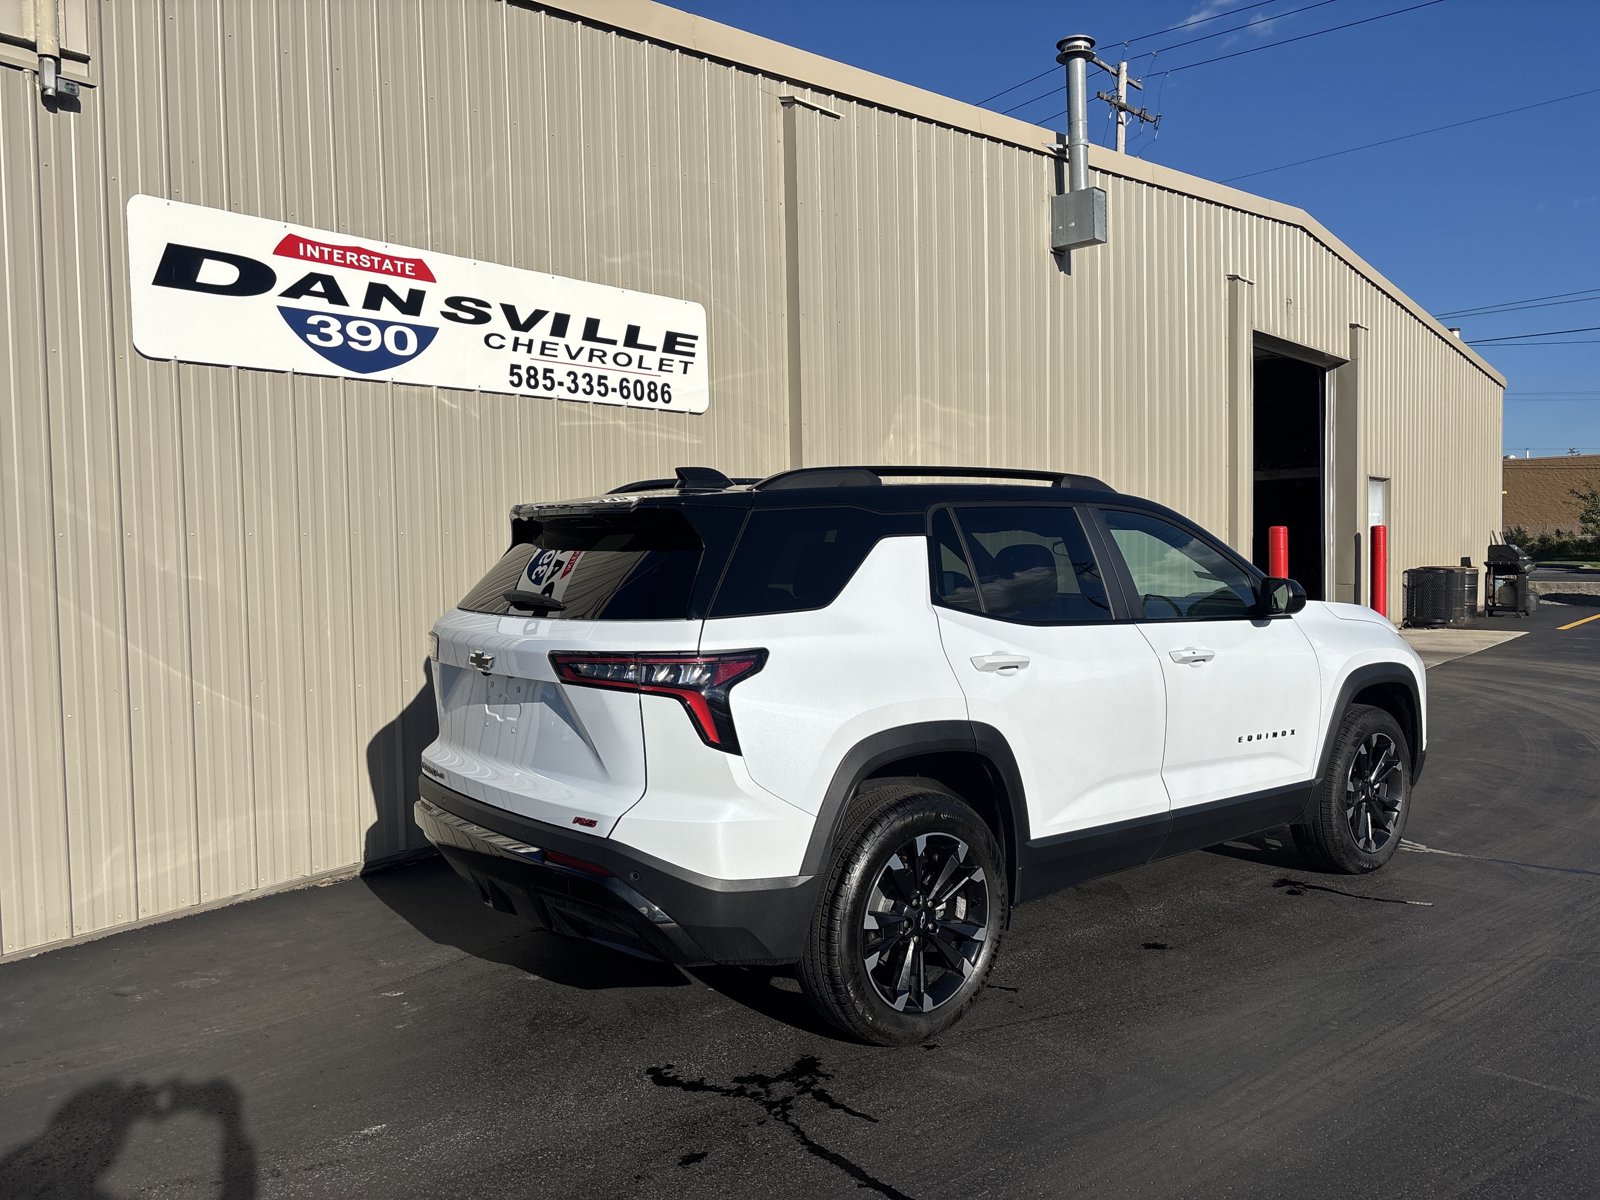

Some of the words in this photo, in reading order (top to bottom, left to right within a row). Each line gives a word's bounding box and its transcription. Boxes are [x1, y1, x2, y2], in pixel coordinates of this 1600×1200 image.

[298, 242, 416, 277] INTERSTATE
[151, 242, 699, 358] DANSVILLE
[306, 314, 418, 356] 390
[483, 332, 695, 375] CHEVROLET
[508, 363, 672, 405] 585-335-6086
[1237, 728, 1296, 744] EQUINOX
